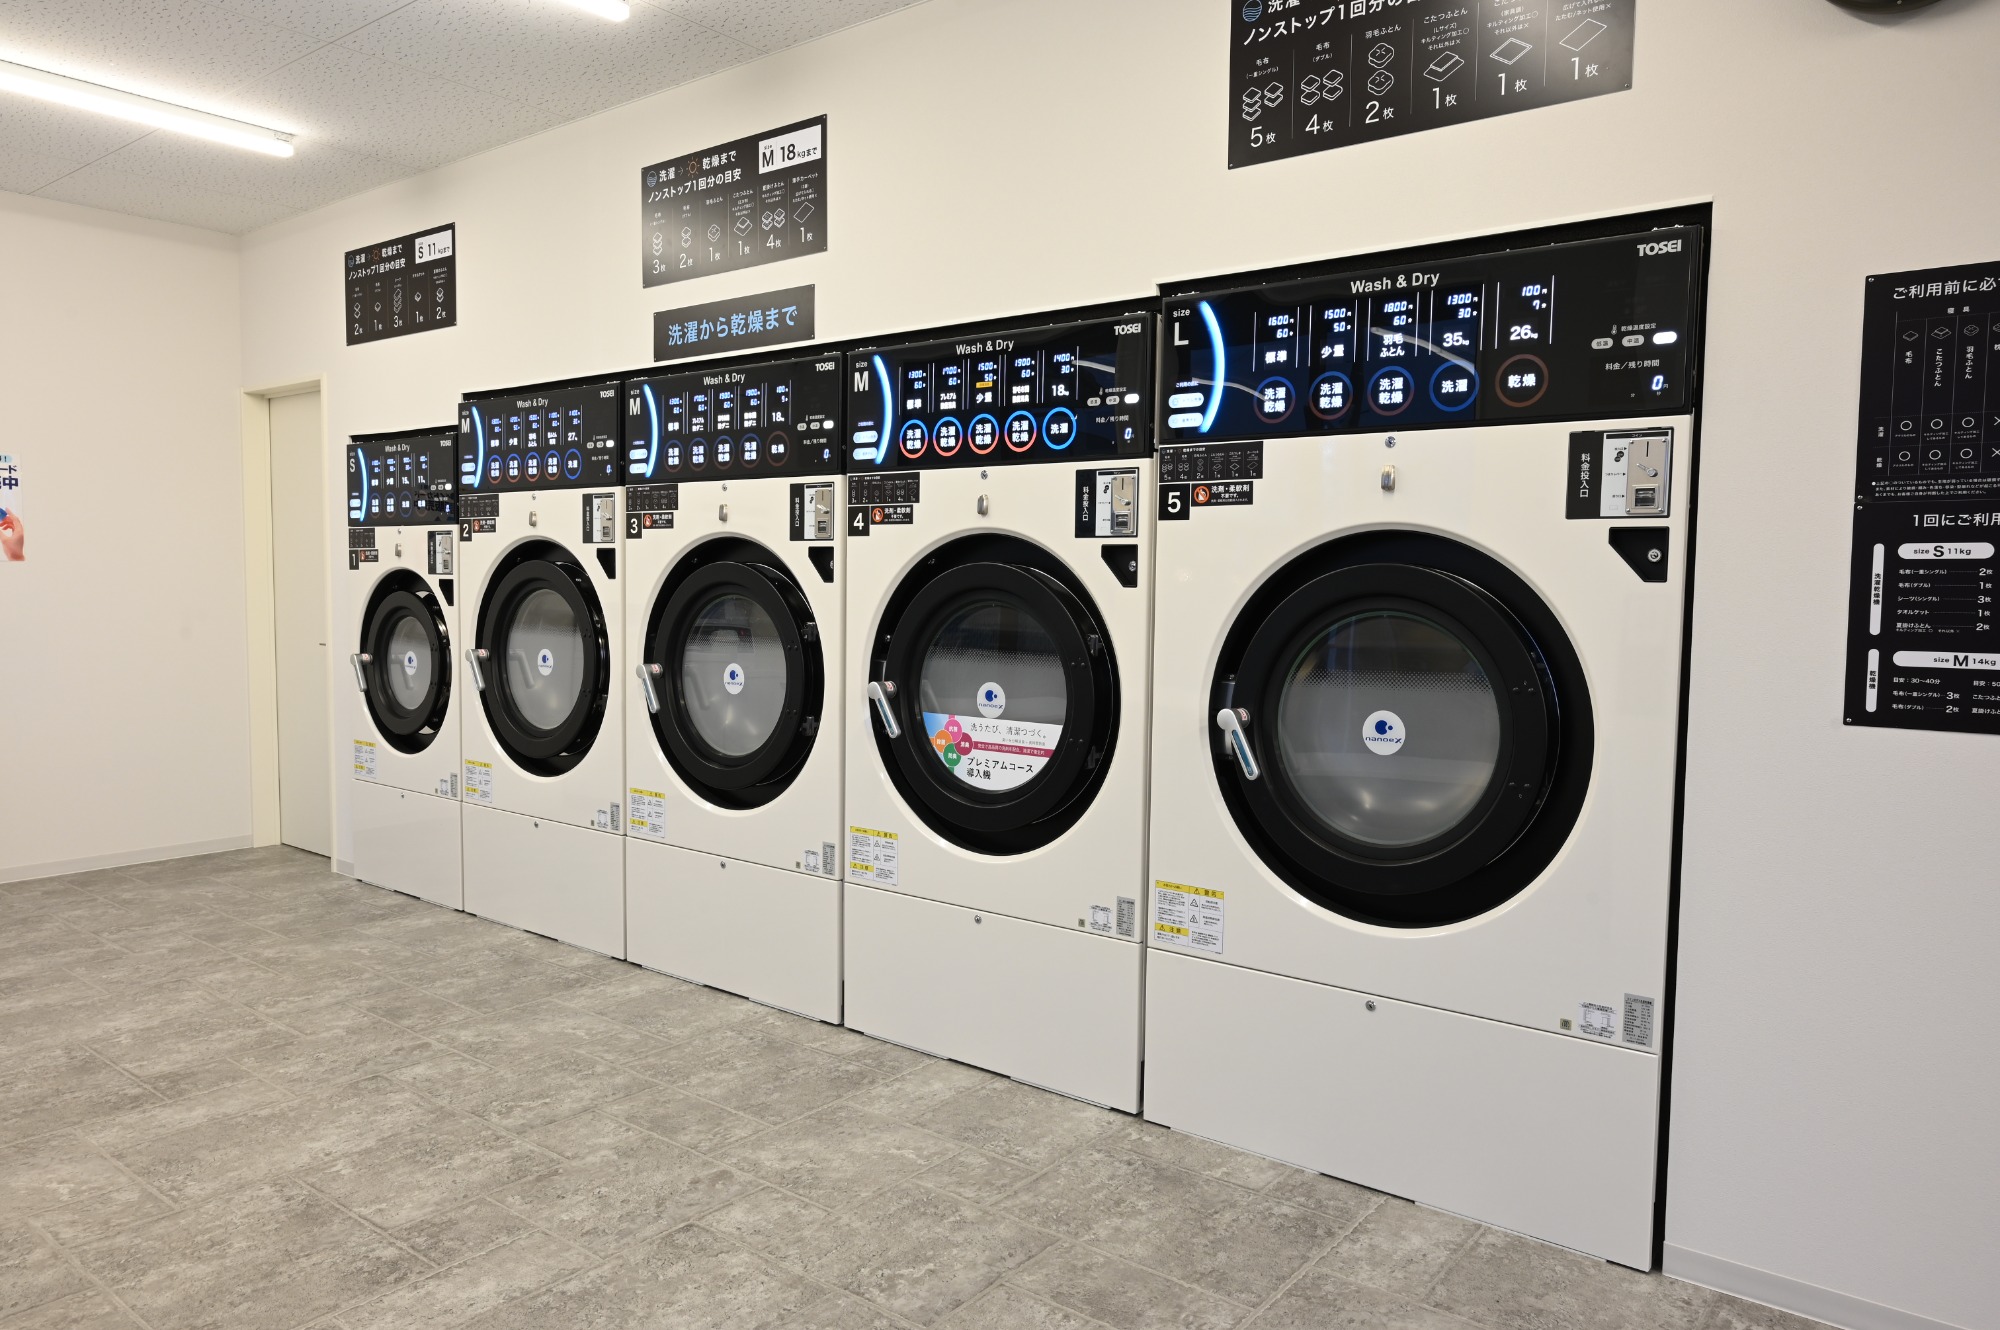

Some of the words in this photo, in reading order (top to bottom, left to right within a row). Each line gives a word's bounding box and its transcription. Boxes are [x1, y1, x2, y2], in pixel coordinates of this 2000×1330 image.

[1424, 8, 1468, 24] こたつふとん
[1365, 24, 1401, 39] 羽毛ふとん
[1316, 42, 1330, 51] 毛布
[1256, 57, 1269, 66] 毛布
[1571, 57, 1598, 80] 1枚
[1498, 73, 1528, 96] 1枚
[1432, 87, 1457, 109] 1枚
[1365, 101, 1394, 124] 2枚
[1306, 114, 1334, 134] 4枚
[1251, 126, 1276, 147] 5枚
[659, 167, 676, 182] 洗濯
[702, 150, 736, 170] 乾燥まで
[762, 150, 774, 168] M
[648, 168, 742, 202] ノンストップ1回分の目安
[767, 234, 781, 249] 4枚
[800, 227, 812, 242] 1枚
[709, 247, 720, 262] 1枚
[738, 241, 750, 255] 1枚
[1637, 239, 1682, 256] TOSEI
[653, 260, 666, 273] 3枚
[680, 254, 692, 268] 2枚
[349, 258, 406, 280] ノンストップ1回分の目安
[1351, 274, 1391, 294] Wash
[1396, 272, 1408, 288] &
[1412, 272, 1440, 291] Dry
[1173, 308, 1190, 317] size
[668, 306, 798, 346] 洗濯から乾燥まで
[1114, 323, 1141, 335] TOSEI
[1510, 325, 1538, 340] 26kg
[1621, 323, 1656, 331] 乾燥温度設定
[1174, 322, 1189, 346] L
[1383, 333, 1403, 345] 羽毛
[1443, 332, 1469, 347] 35kg
[956, 342, 982, 355] Wash
[986, 341, 993, 351] &
[996, 340, 1014, 351] Dry
[1321, 344, 1344, 358] 少量
[1380, 346, 1405, 358] ふとん
[1265, 350, 1287, 364] 標準
[1965, 346, 1974, 379] 羽毛ふとん
[815, 362, 835, 371] TOSEI
[1934, 348, 1942, 386] こたつふとん
[704, 375, 722, 385] Wash
[725, 374, 730, 382] &
[732, 373, 745, 383] Dry
[854, 371, 868, 392] M
[1380, 377, 1403, 390] 洗濯
[1442, 379, 1467, 393] 洗濯
[1508, 374, 1536, 388] 乾燥
[600, 390, 614, 398] TOSEI
[1264, 387, 1286, 400] 洗濯
[1320, 382, 1343, 395] 洗濯
[538, 398, 548, 407] Dry
[1319, 396, 1342, 409] 乾燥
[1379, 391, 1402, 404] 乾燥
[630, 398, 640, 415] M
[1264, 400, 1285, 413] 乾燥
[462, 418, 470, 433] M
[940, 426, 955, 436] 洗濯
[976, 423, 991, 434] 洗濯
[1012, 421, 1028, 431] 洗濯
[1051, 423, 1068, 434] 洗濯
[907, 429, 921, 439] 洗濯
[976, 434, 991, 444] 乾燥
[1012, 432, 1028, 442] 乾燥
[907, 440, 921, 450] 乾燥
[940, 437, 955, 447] 乾燥
[350, 459, 355, 472] S
[1580, 453, 1590, 498] 料金投入口
[1211, 484, 1249, 493] 洗剤・柔軟剤
[1168, 492, 1181, 513] 5
[631, 518, 638, 533] 3
[854, 513, 864, 530] 4
[463, 524, 469, 537] 2
[1933, 545, 1944, 558] S
[1953, 655, 1968, 667] M
[971, 723, 1046, 738] 洗うたび、清潔つづく。
[968, 757, 1033, 773] プレミアムコース
[967, 767, 991, 780] 導入機
